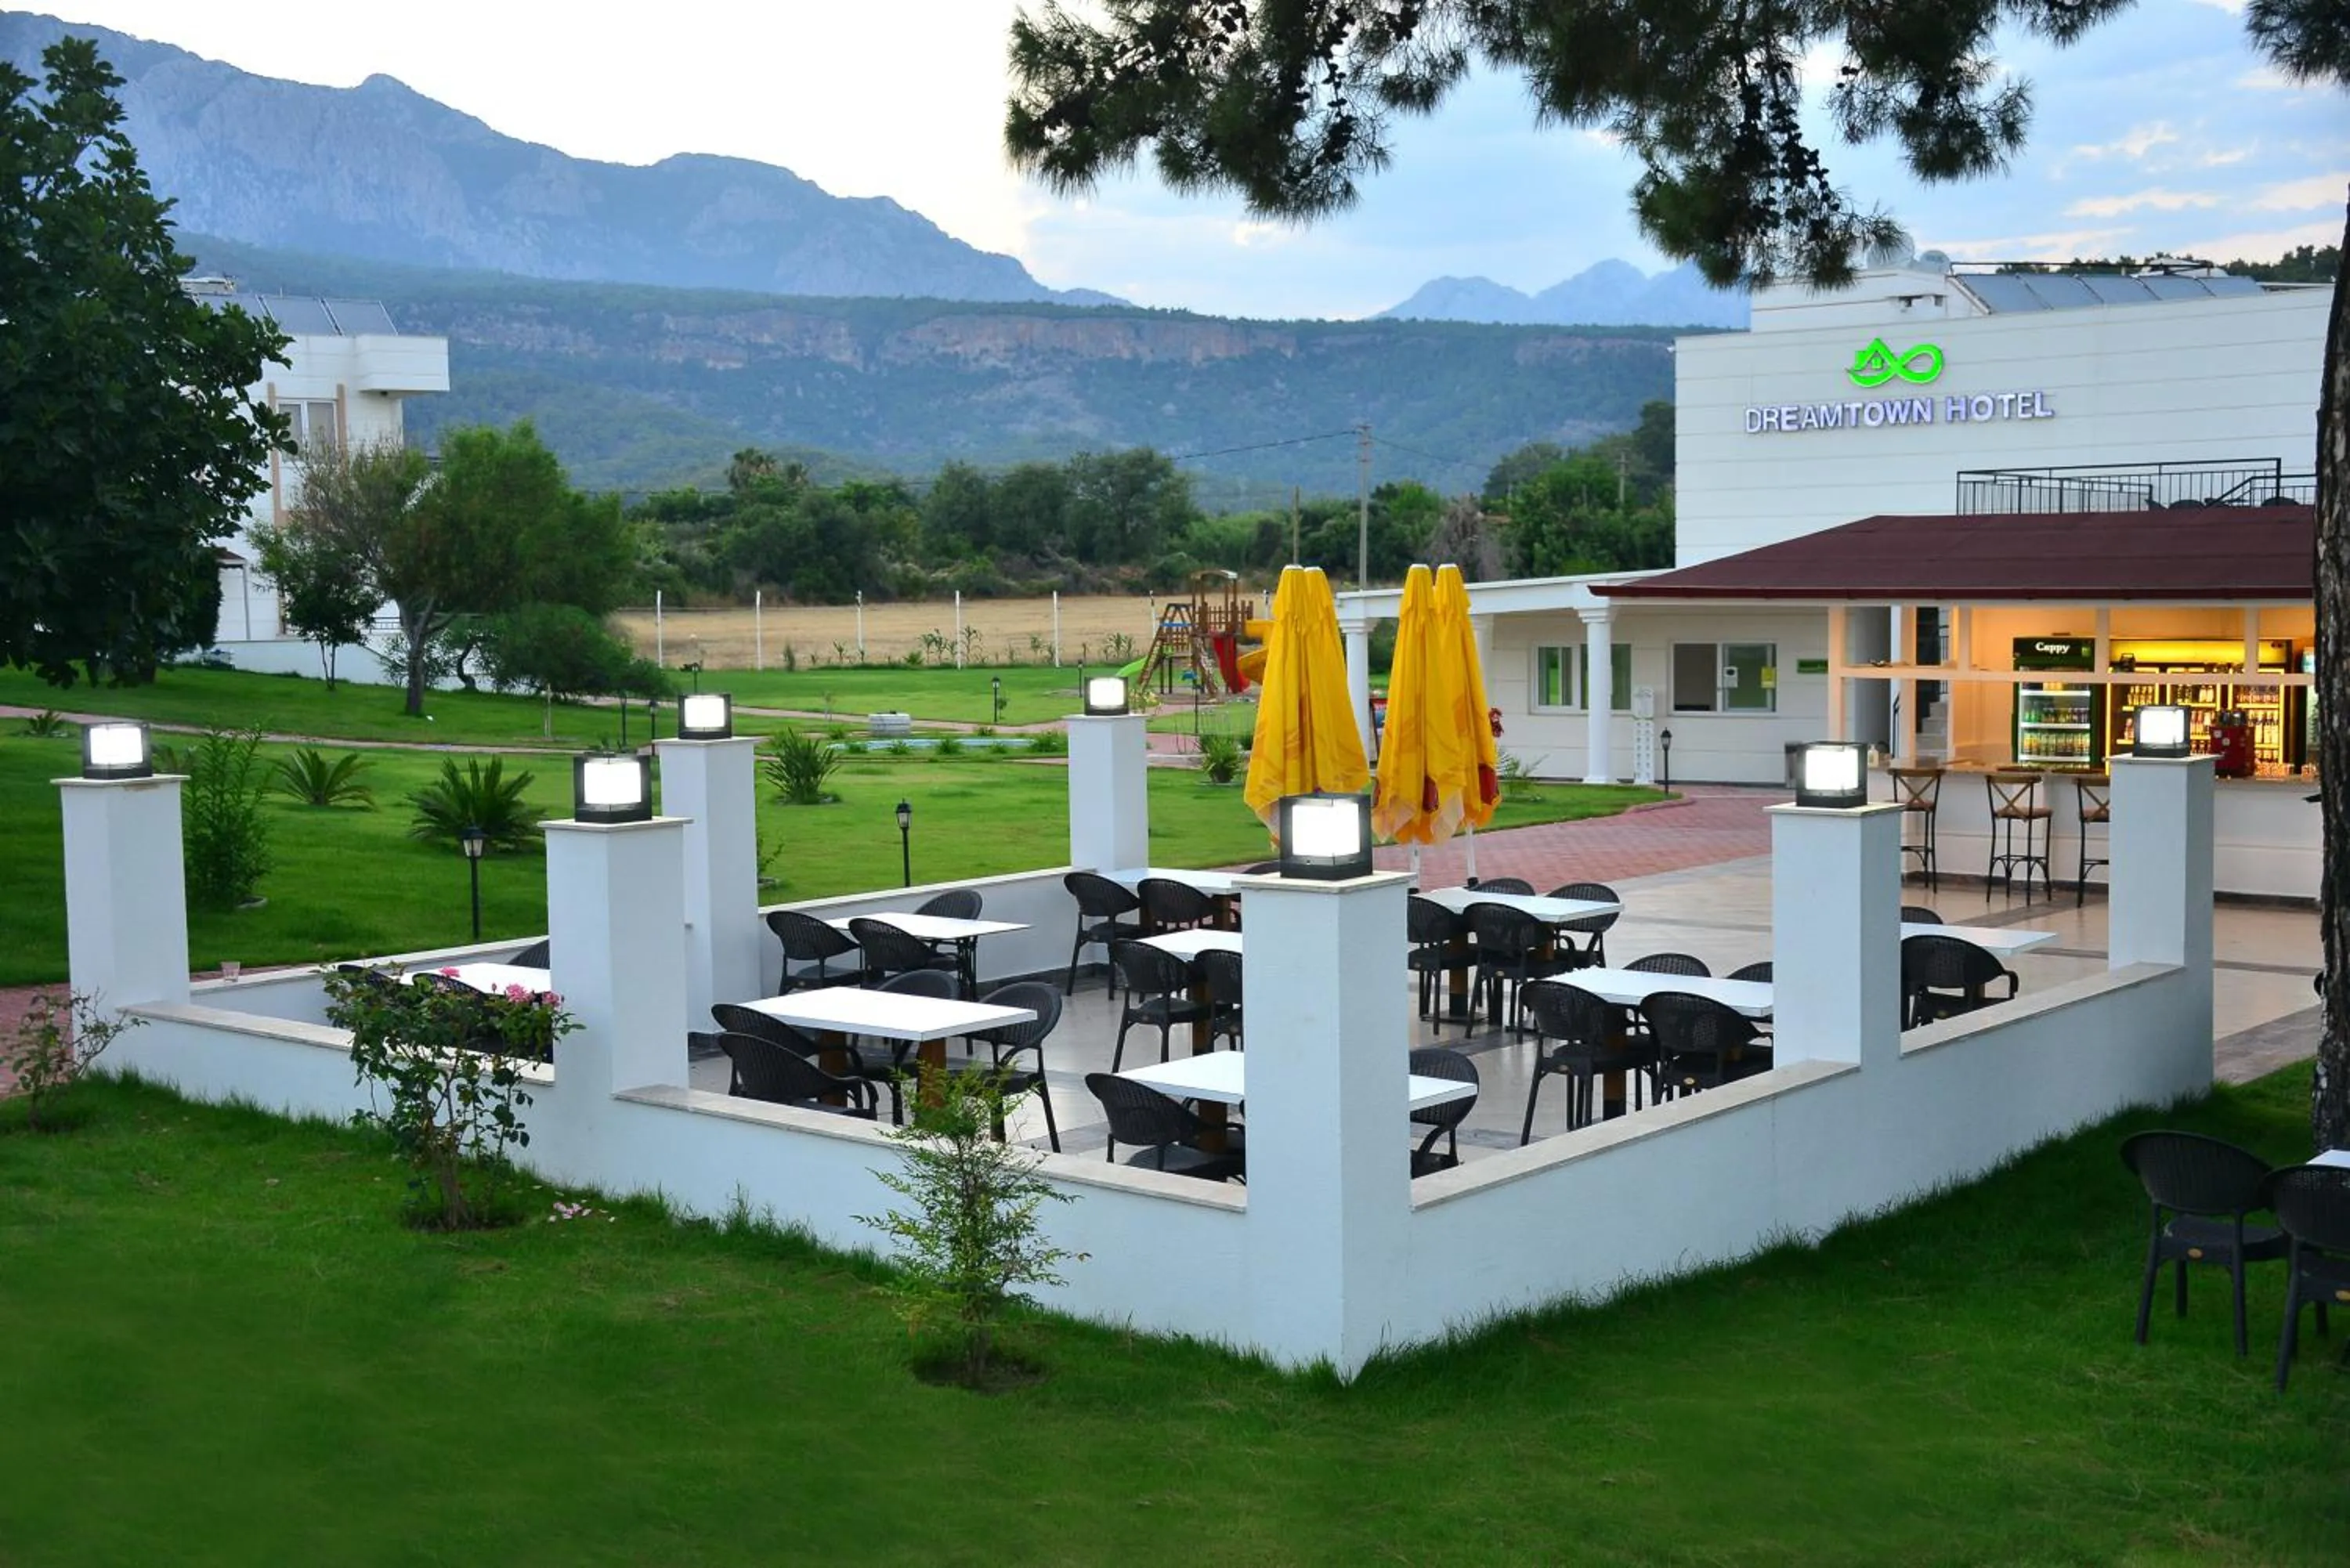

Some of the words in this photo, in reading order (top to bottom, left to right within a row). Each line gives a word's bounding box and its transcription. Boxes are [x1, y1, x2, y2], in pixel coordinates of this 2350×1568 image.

[1745, 397, 1933, 433] DREAMTOWN
[1945, 392, 2054, 422] HOTEL
[2035, 641, 2070, 655] Cappy
